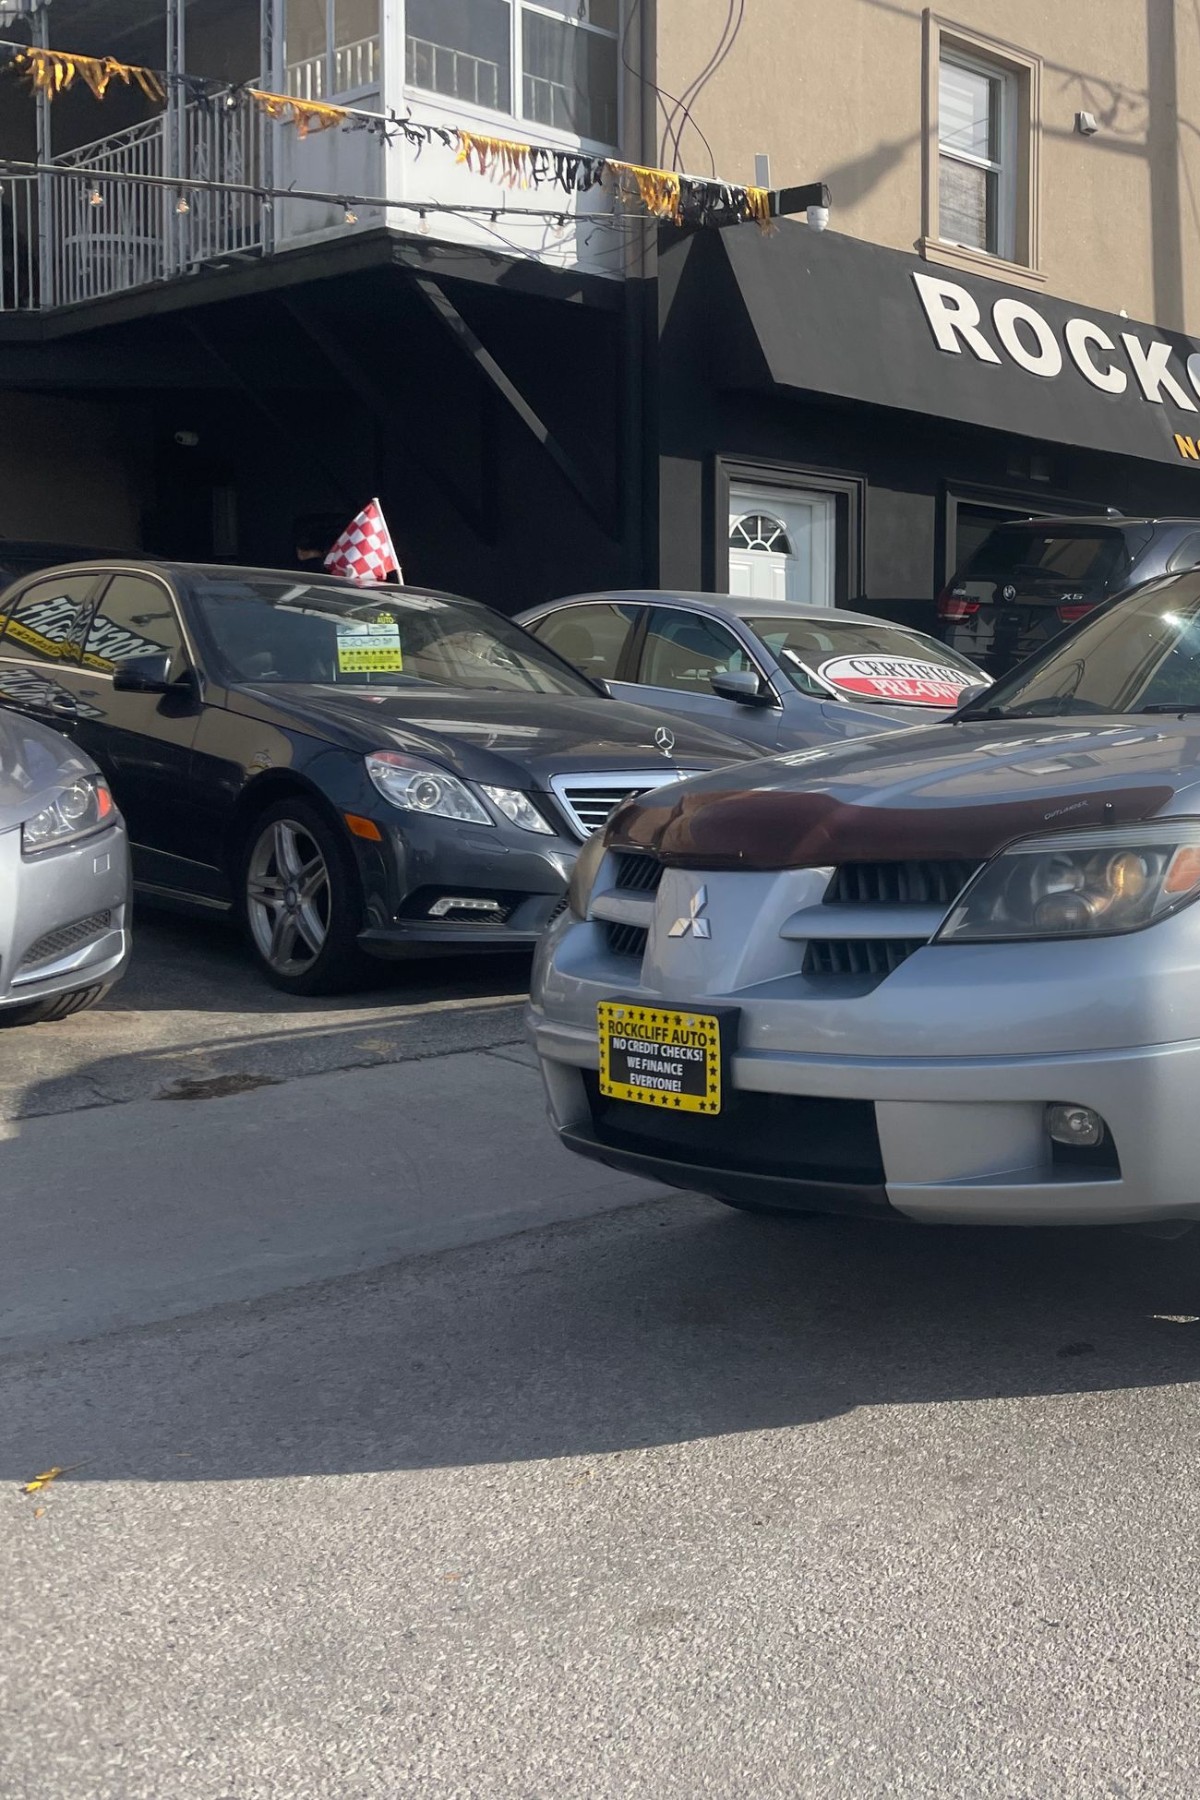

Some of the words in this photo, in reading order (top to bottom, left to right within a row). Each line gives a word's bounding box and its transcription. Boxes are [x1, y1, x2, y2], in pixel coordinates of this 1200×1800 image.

[1060, 593, 1085, 601] X5
[849, 660, 970, 686] CERTIFIED
[608, 1019, 668, 1041] ROCKCLIFF
[671, 1029, 707, 1047] AUTO
[613, 1037, 626, 1050] NO
[627, 1040, 659, 1055] CREDIT
[660, 1045, 703, 1062] CHECKS!
[627, 1056, 641, 1070] WE
[642, 1058, 683, 1076] FINANCE
[629, 1072, 682, 1092] EVERYONE!
